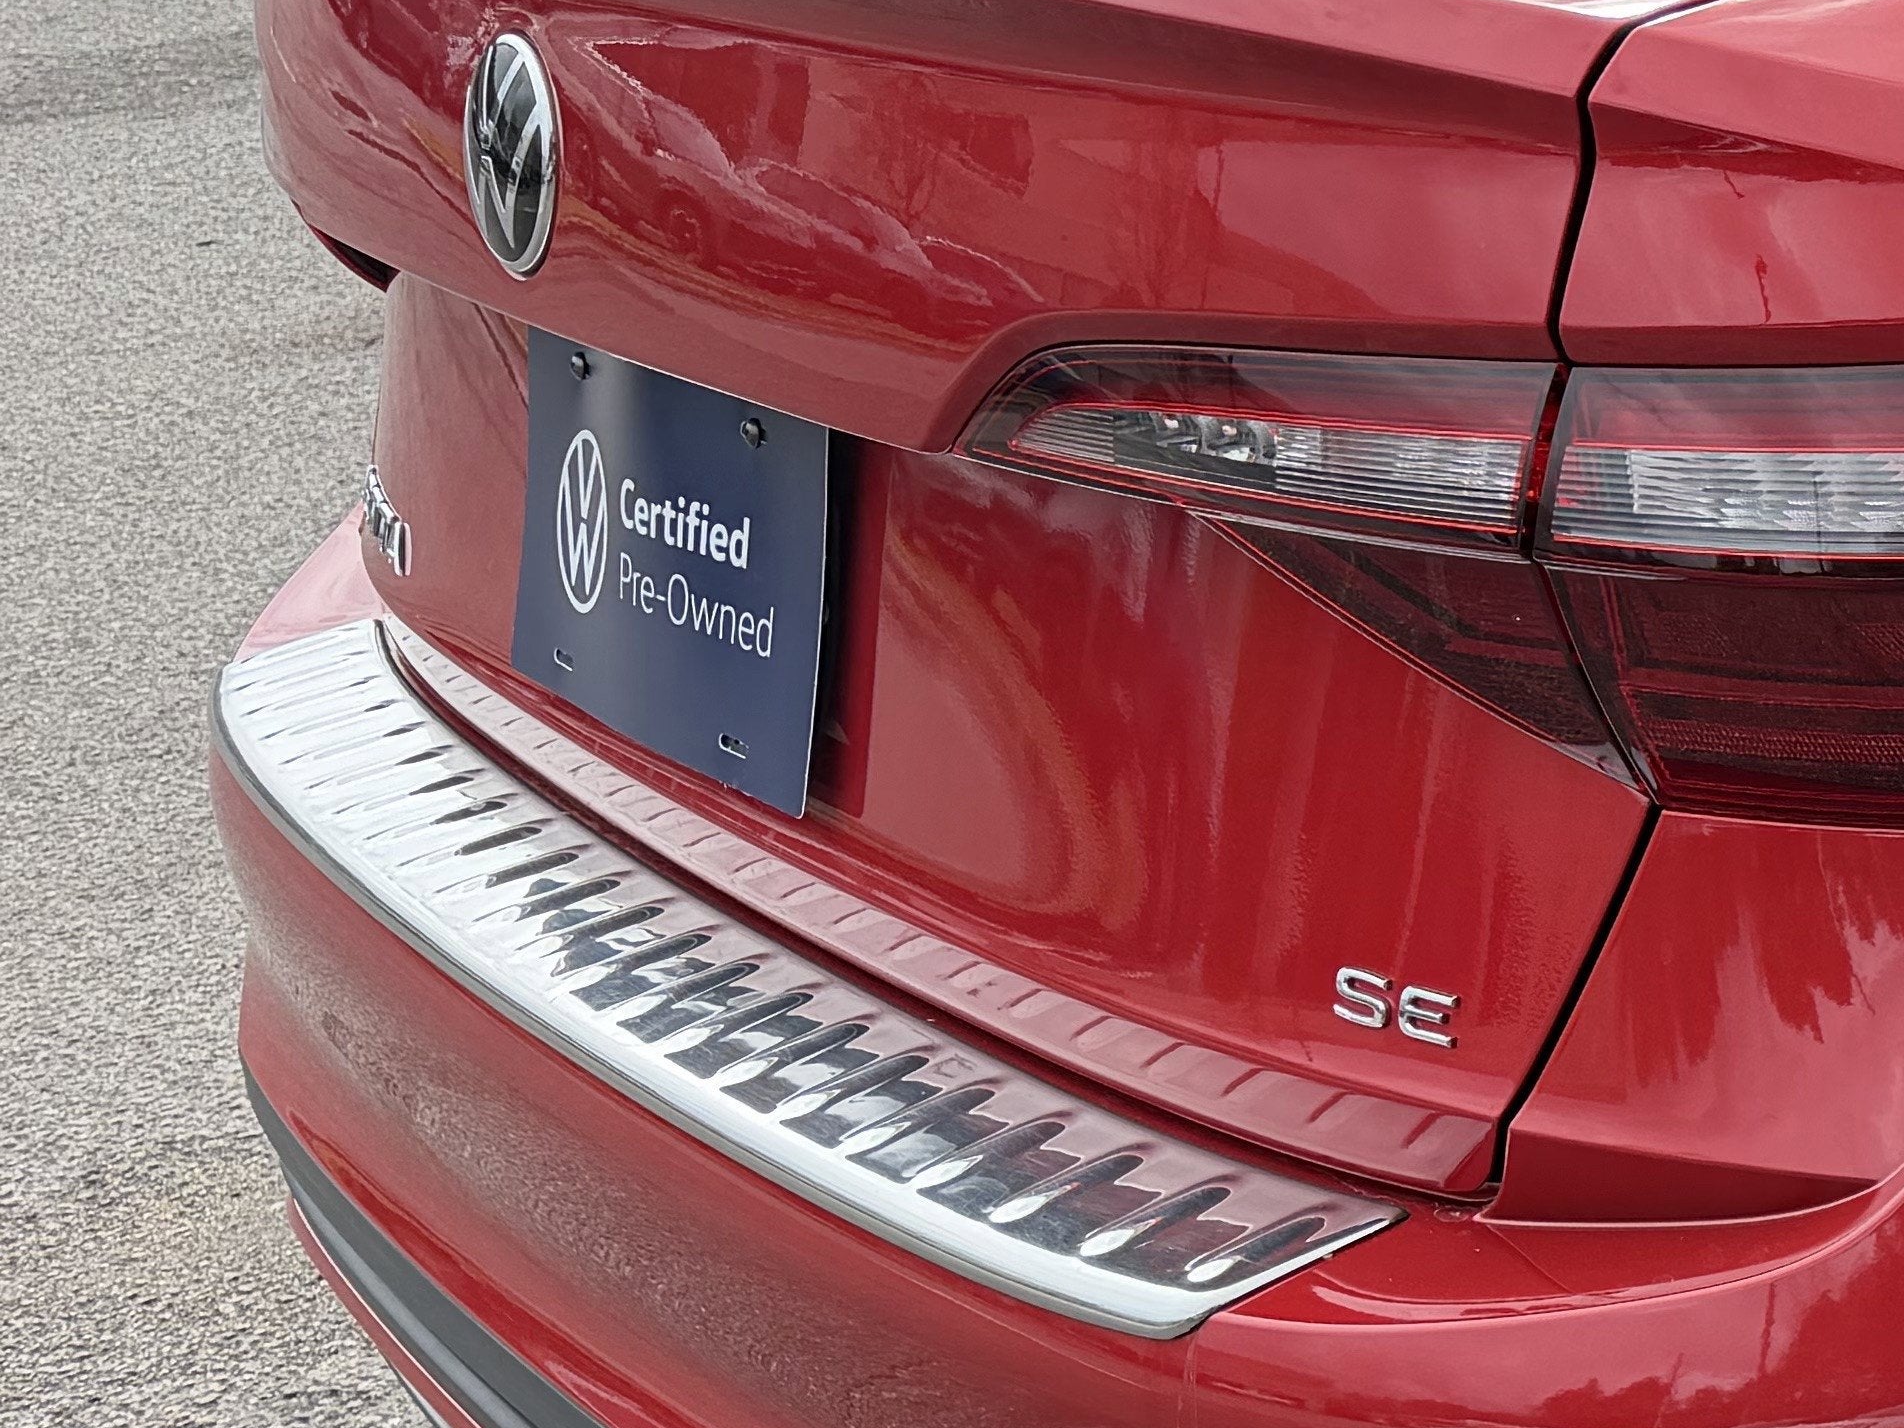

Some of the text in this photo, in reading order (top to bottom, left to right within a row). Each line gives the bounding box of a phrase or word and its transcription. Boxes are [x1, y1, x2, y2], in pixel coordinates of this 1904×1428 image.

[620, 479, 751, 569] Certified
[619, 552, 774, 658] Pre-Owned
[1333, 966, 1461, 1049] SE
